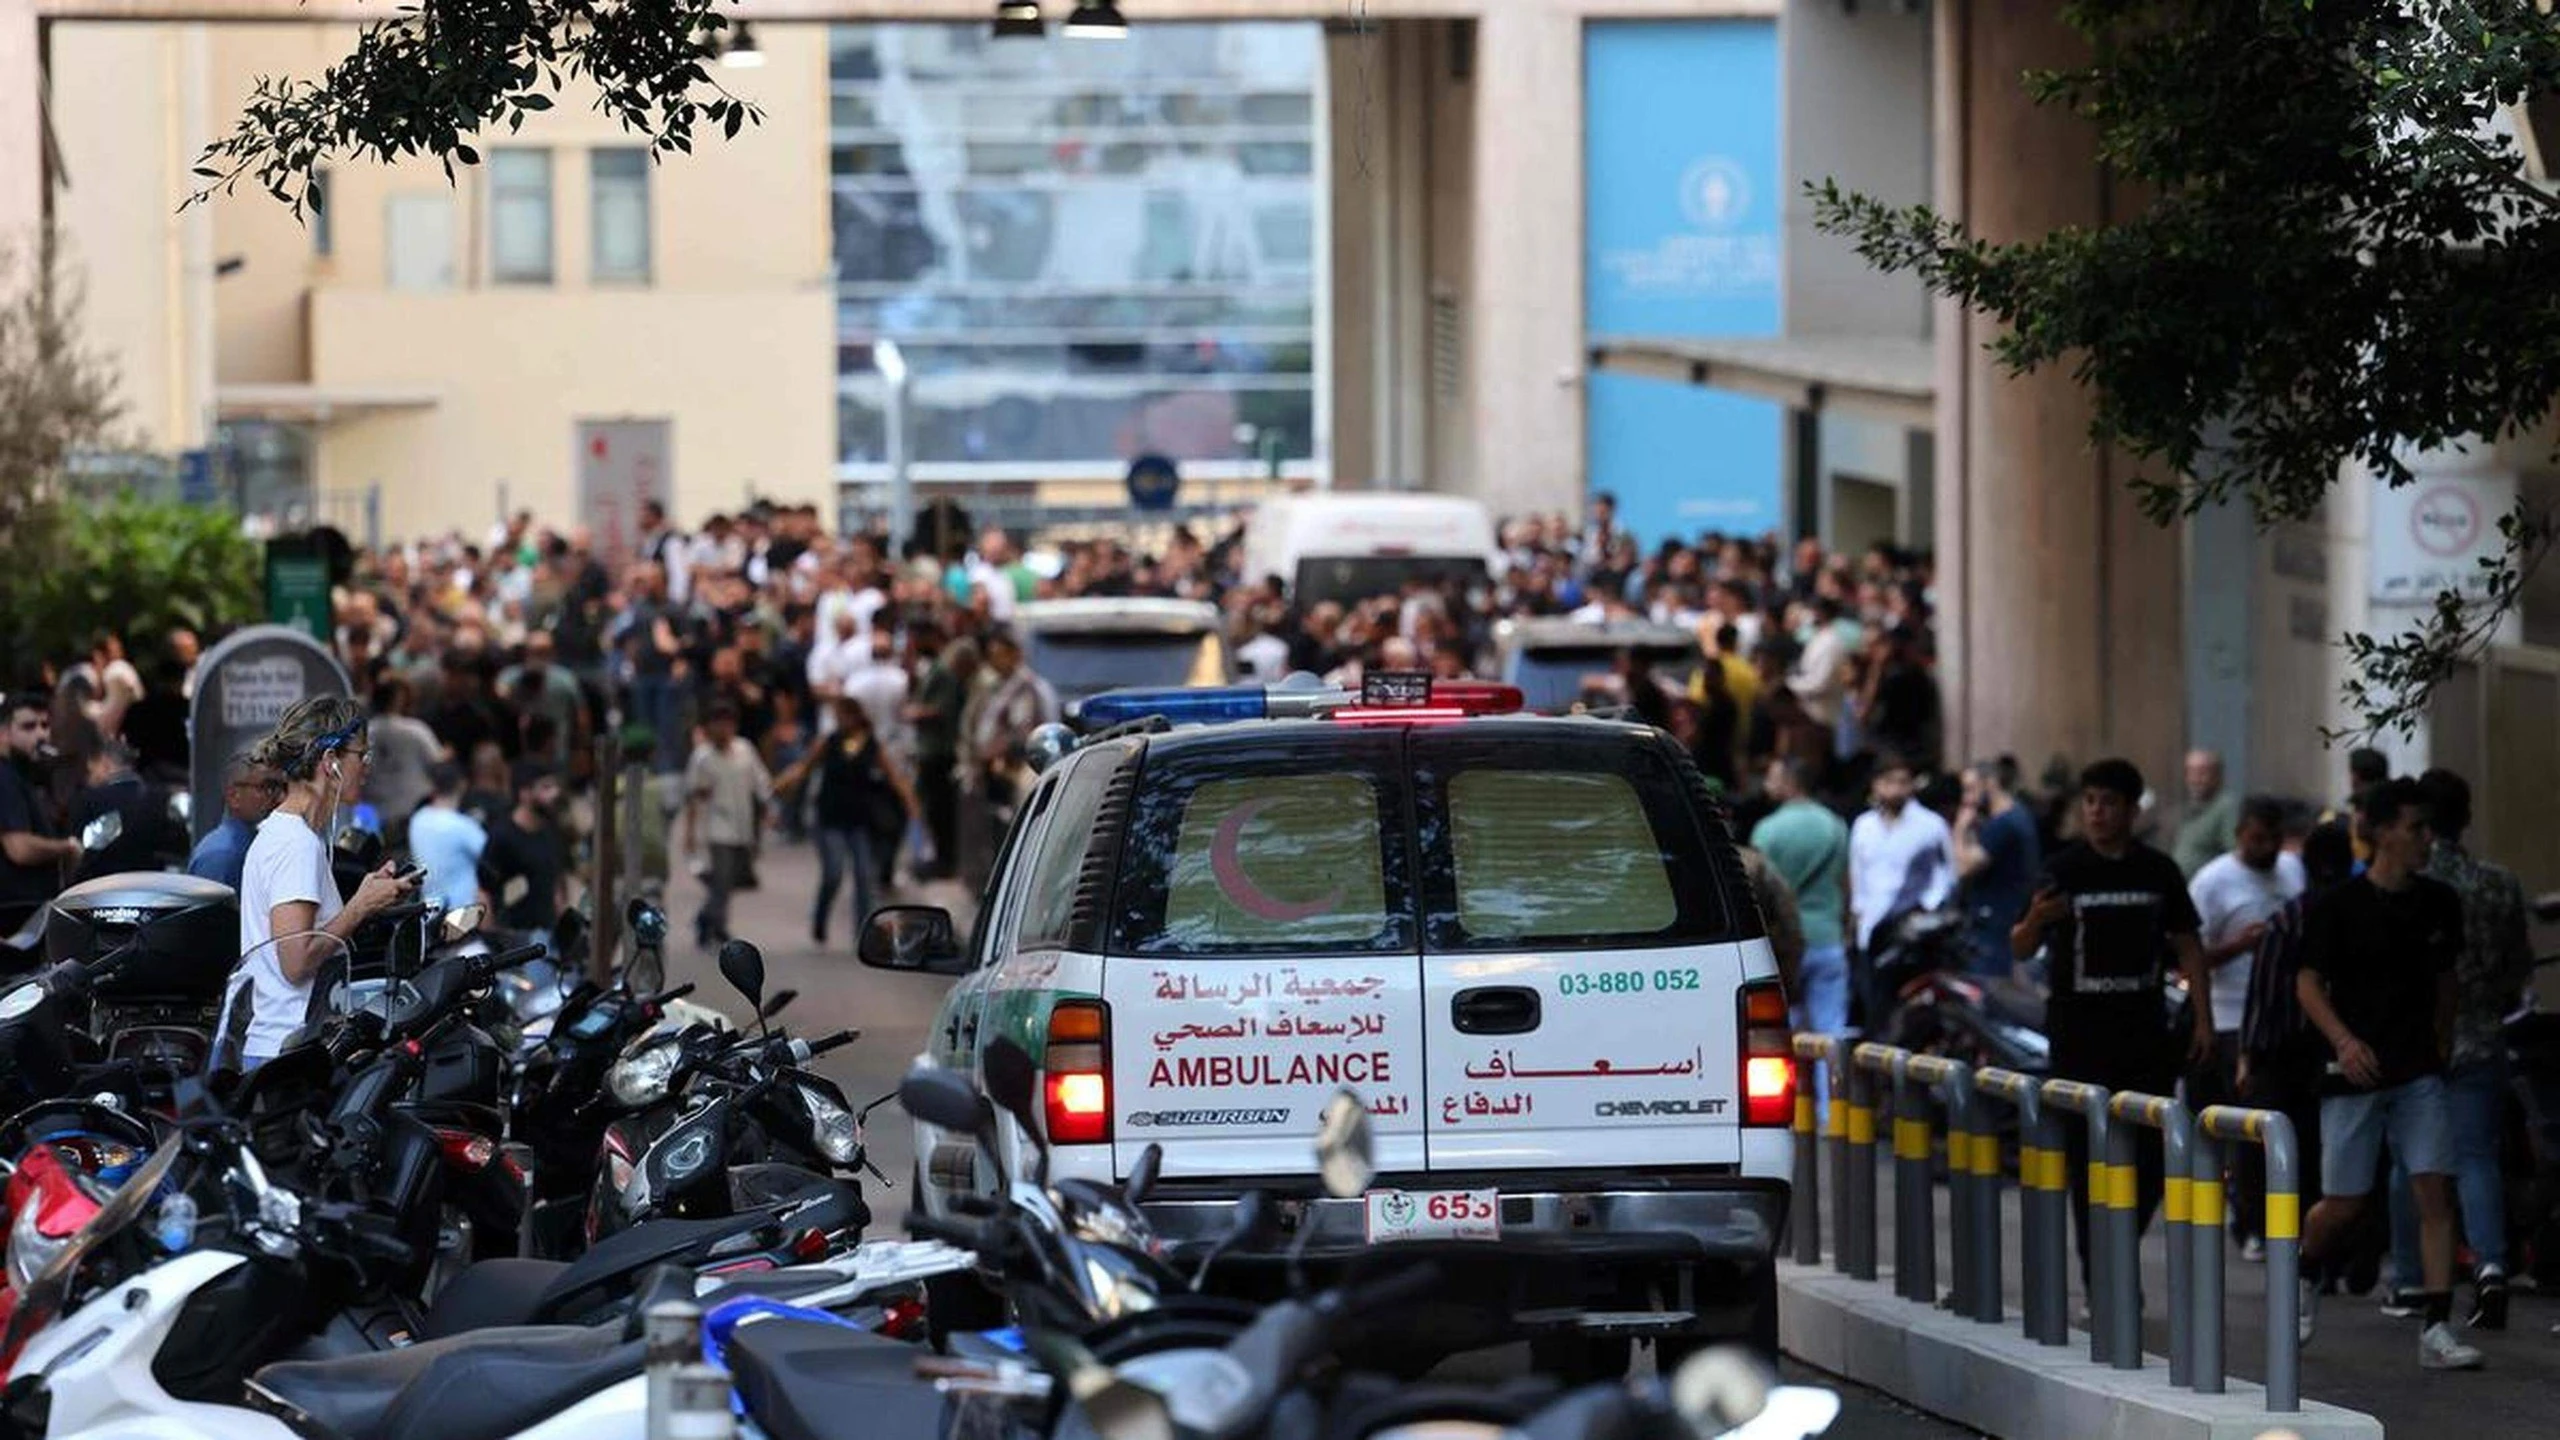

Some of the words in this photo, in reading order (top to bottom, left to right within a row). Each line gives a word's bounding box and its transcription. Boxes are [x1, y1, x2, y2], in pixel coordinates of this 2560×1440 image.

[1152, 971, 1273, 1006] الرسالة
[1282, 967, 1386, 1005] جمعية
[1558, 970, 1645, 996] 03-880
[1653, 968, 1700, 991] 052
[1152, 1016, 1258, 1051] الصحي
[1265, 1009, 1387, 1044] للإسعاف
[1148, 1051, 1391, 1089] AMBULANCE
[1463, 1045, 1704, 1080] إسعاف
[1154, 1108, 1291, 1127] SUBURBAN
[1441, 1090, 1533, 1124] الدفاع
[1594, 1098, 1729, 1118] CHEVROLET
